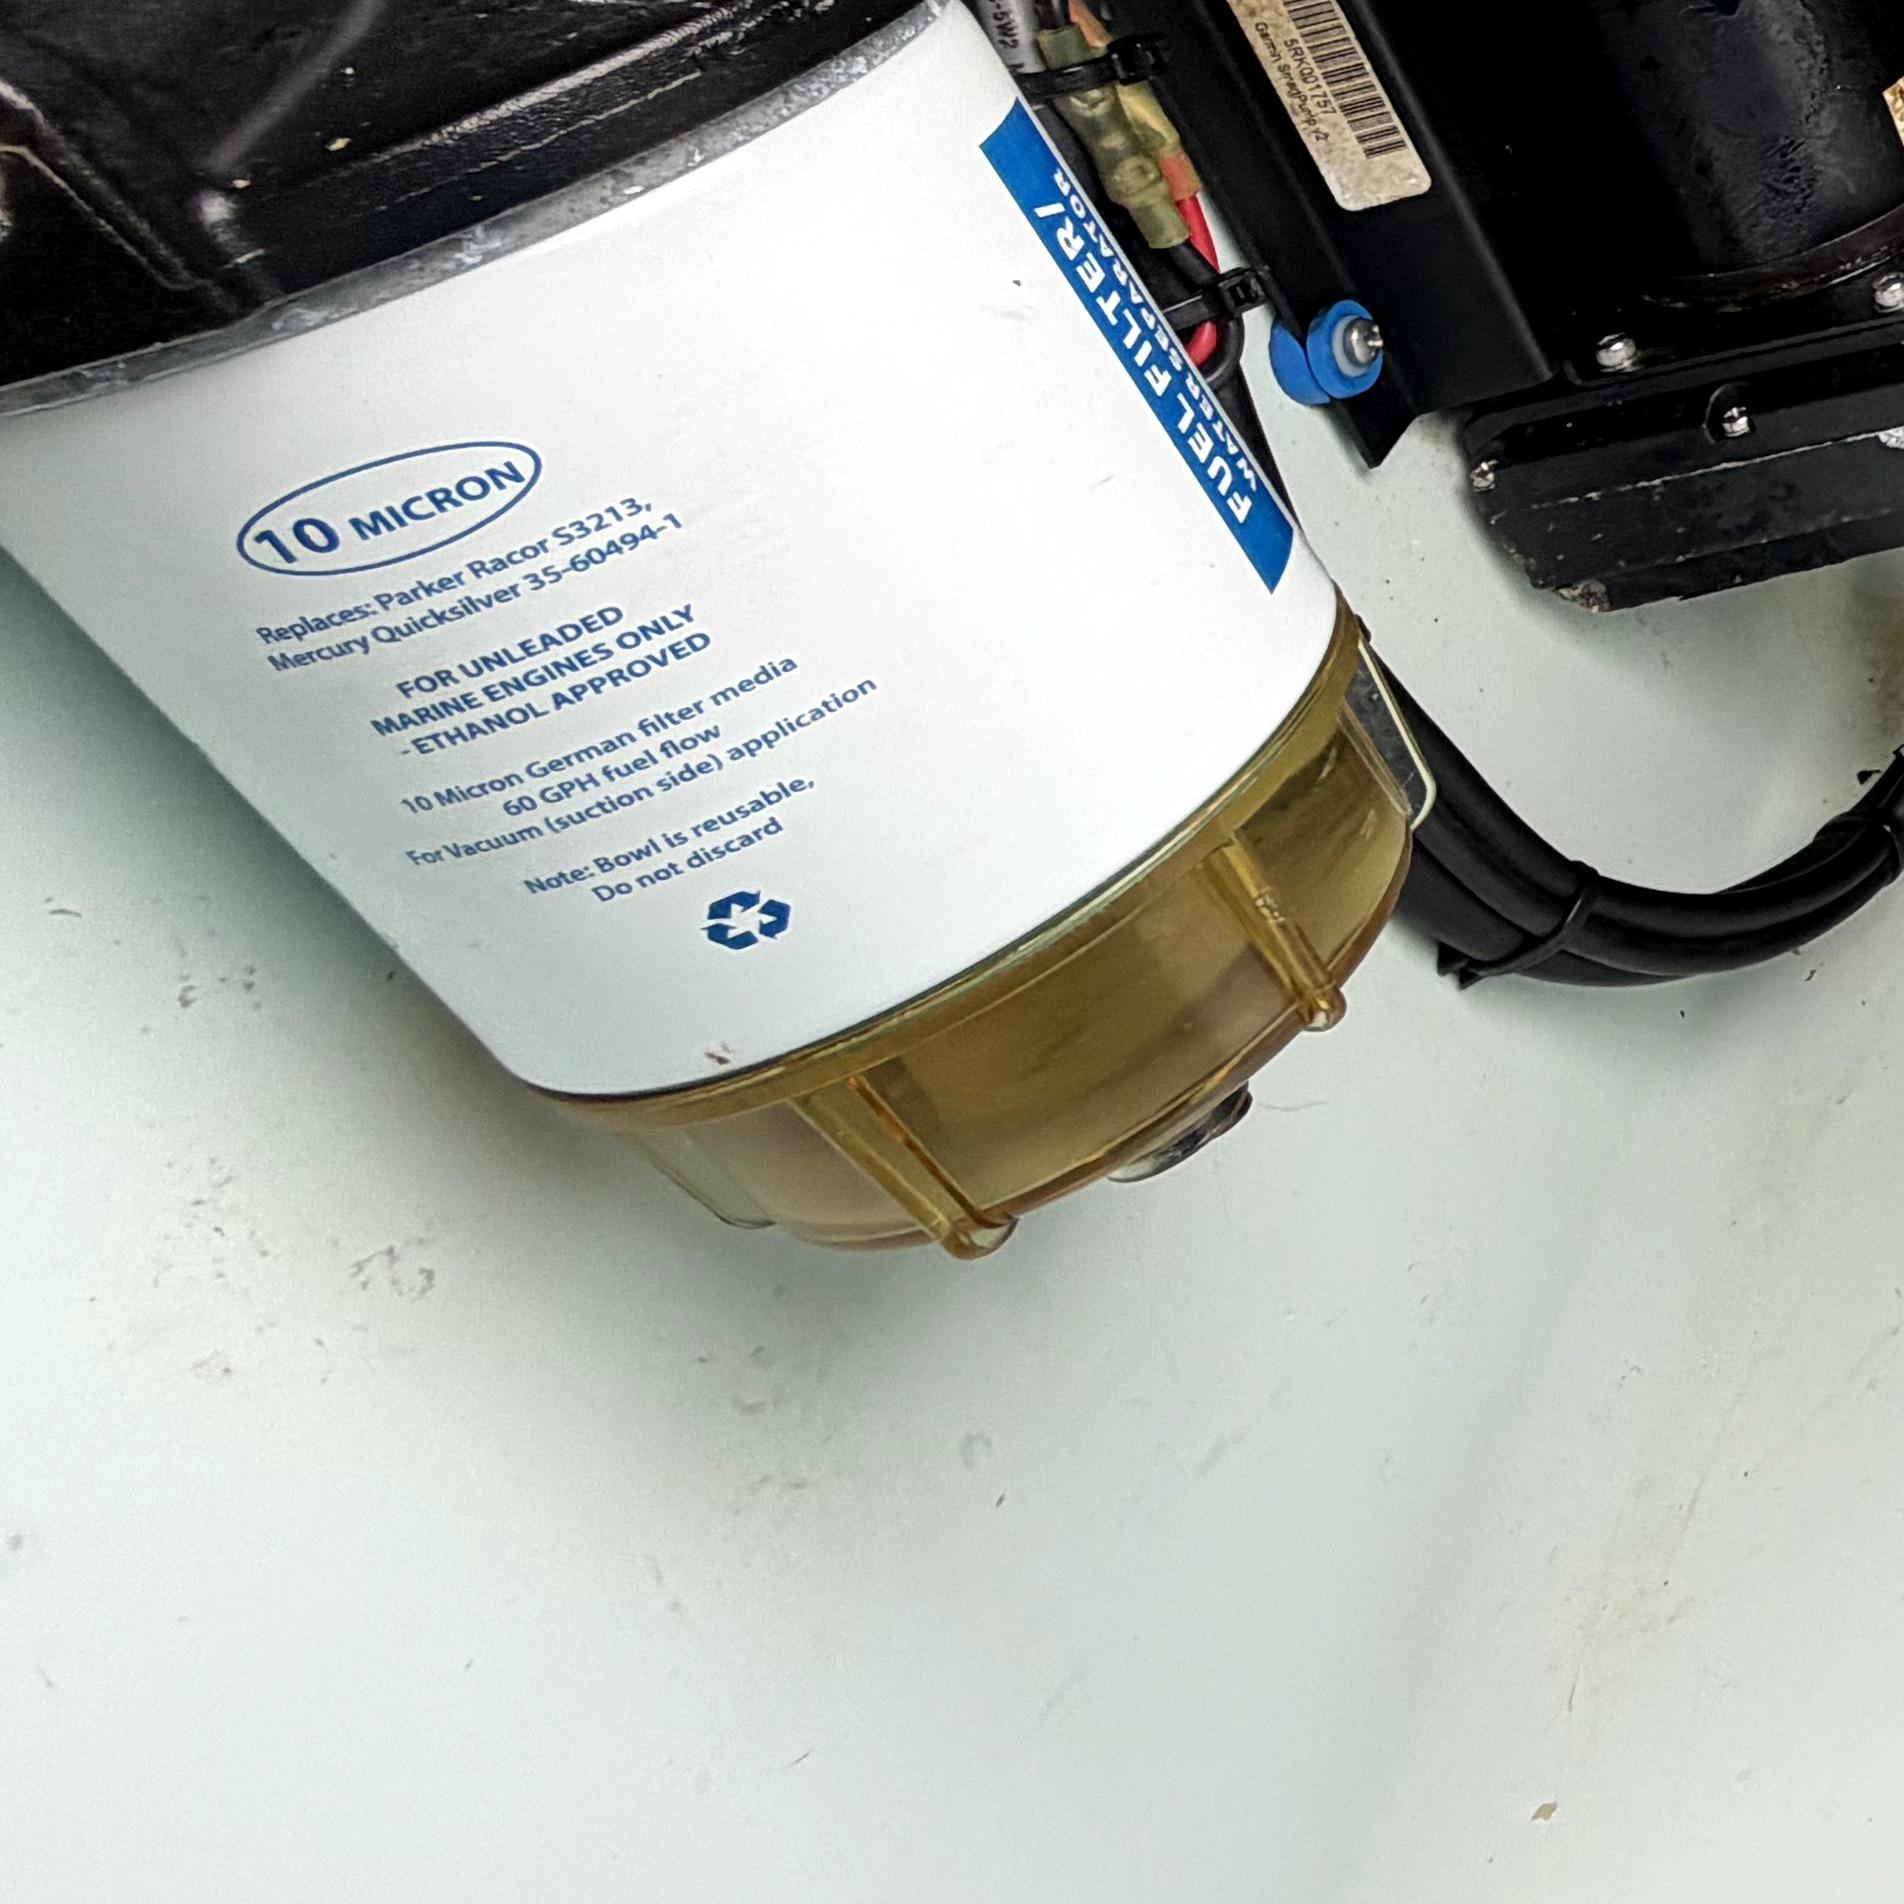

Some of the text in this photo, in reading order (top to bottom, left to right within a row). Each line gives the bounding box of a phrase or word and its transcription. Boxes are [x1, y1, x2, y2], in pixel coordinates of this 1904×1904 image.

[1254, 20, 1282, 64] Garmin
[1285, 37, 1336, 119] 5RK001757
[1033, 201, 1254, 525] FUEL FILTER/
[1052, 167, 1258, 493] WATER SEPARATOR
[253, 461, 526, 564] 10 MICRON
[256, 497, 652, 646] Replaces: Parker Racor S3213,
[267, 513, 682, 671] Mercury Quicksilver 35-60494-1
[395, 606, 624, 699] FOR UNLEADED
[370, 603, 694, 736] MARINE ENGINES ONLY
[410, 702, 550, 755] ETHANOL
[551, 633, 711, 711] APPROVED
[401, 658, 798, 813] 10 Micron German filter media
[405, 680, 877, 866] For Vacuum (suction side) application
[503, 725, 721, 816] 60 GPH fuel flow
[523, 779, 814, 894] Note: Bowl is reusable,
[591, 816, 784, 902] Do not discard
